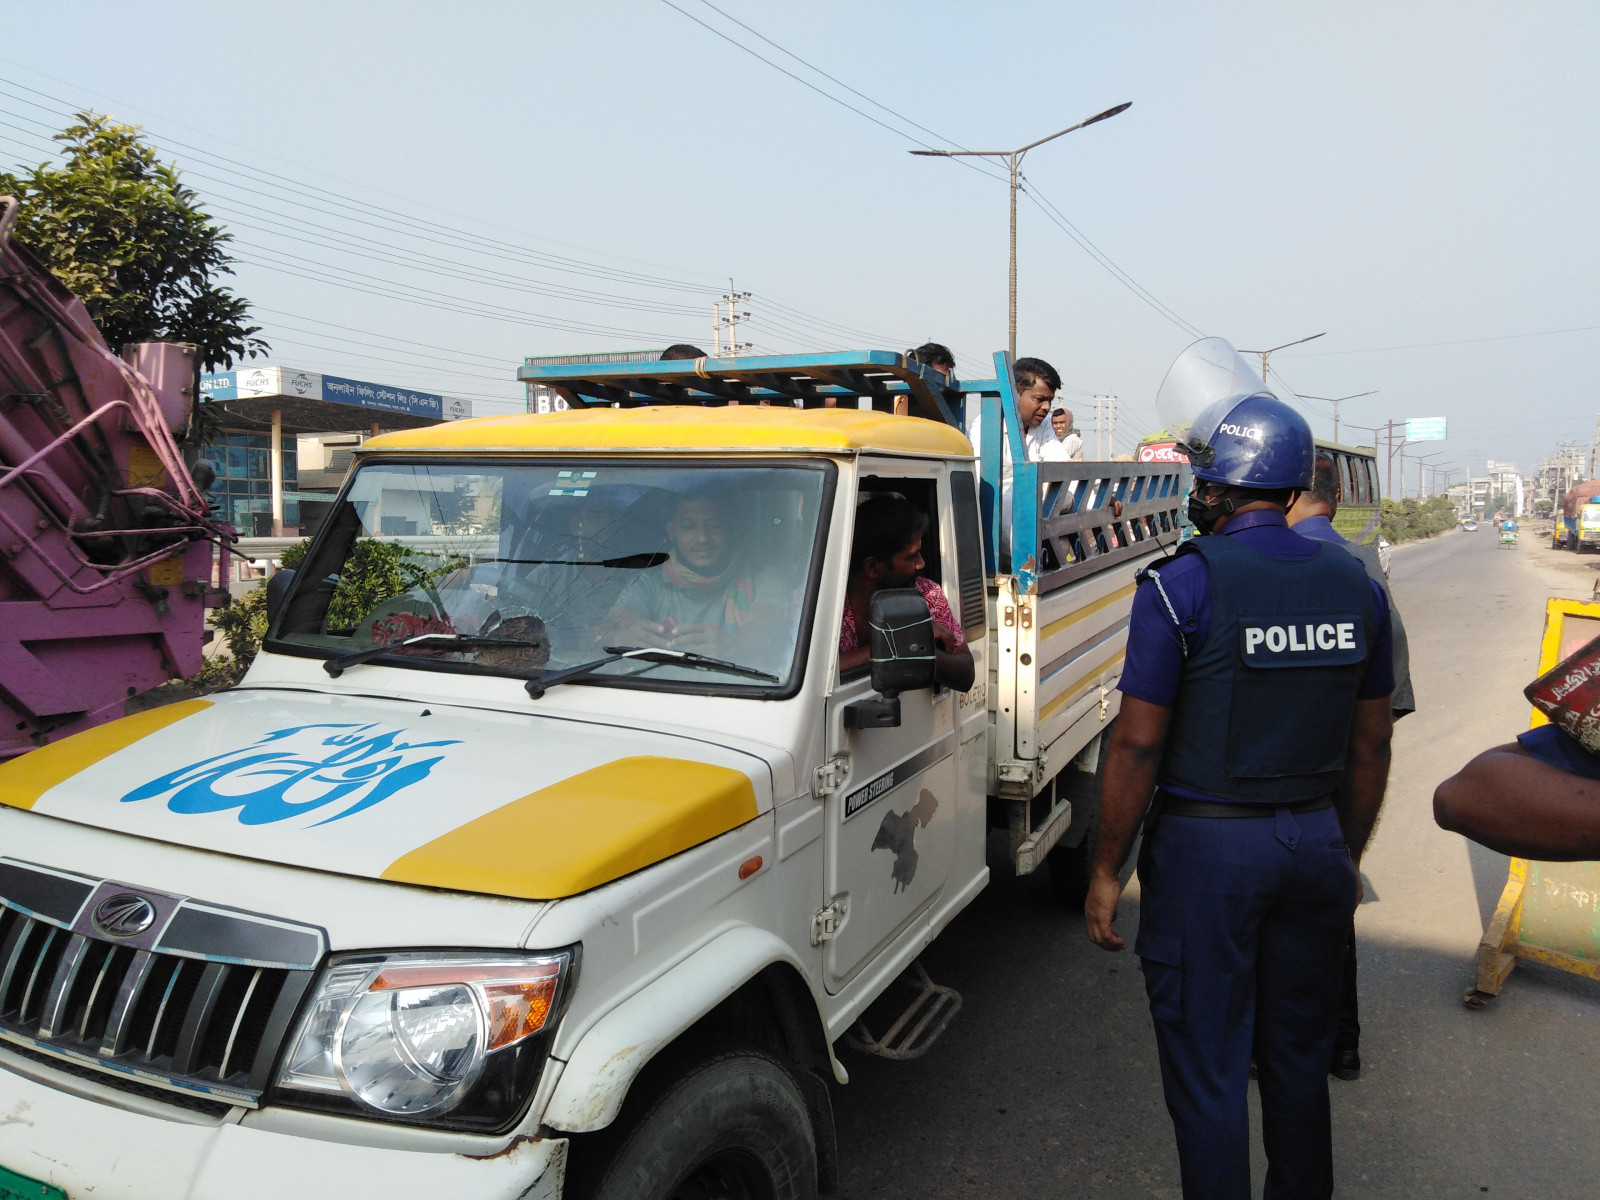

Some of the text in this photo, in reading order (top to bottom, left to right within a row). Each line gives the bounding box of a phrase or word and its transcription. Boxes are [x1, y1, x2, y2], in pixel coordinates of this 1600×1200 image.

[246, 378, 270, 387] FUCHS
[291, 379, 313, 388] FUCHS
[538, 395, 568, 414] BO
[1245, 623, 1356, 655] POLICE
[960, 683, 986, 709] BOLERO
[847, 772, 894, 814] POWER STEERING
